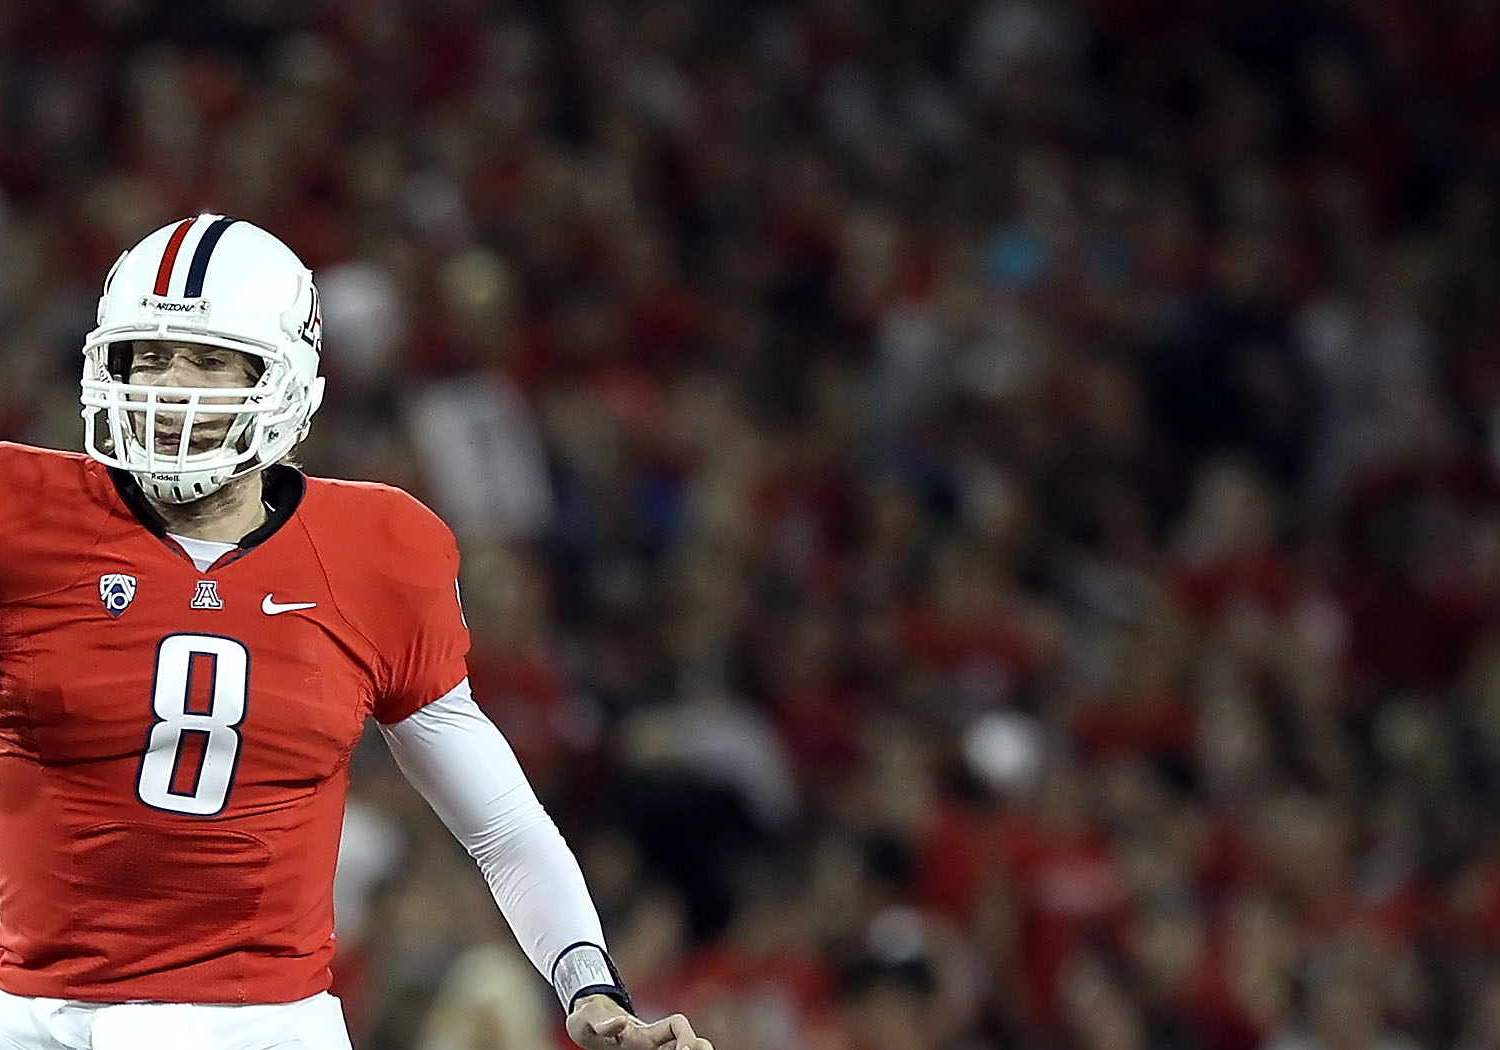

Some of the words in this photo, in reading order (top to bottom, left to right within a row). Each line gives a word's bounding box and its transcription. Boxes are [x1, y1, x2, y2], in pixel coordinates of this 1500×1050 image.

[99, 573, 137, 602] PAC
[106, 592, 129, 610] 10
[133, 631, 251, 818] 8
